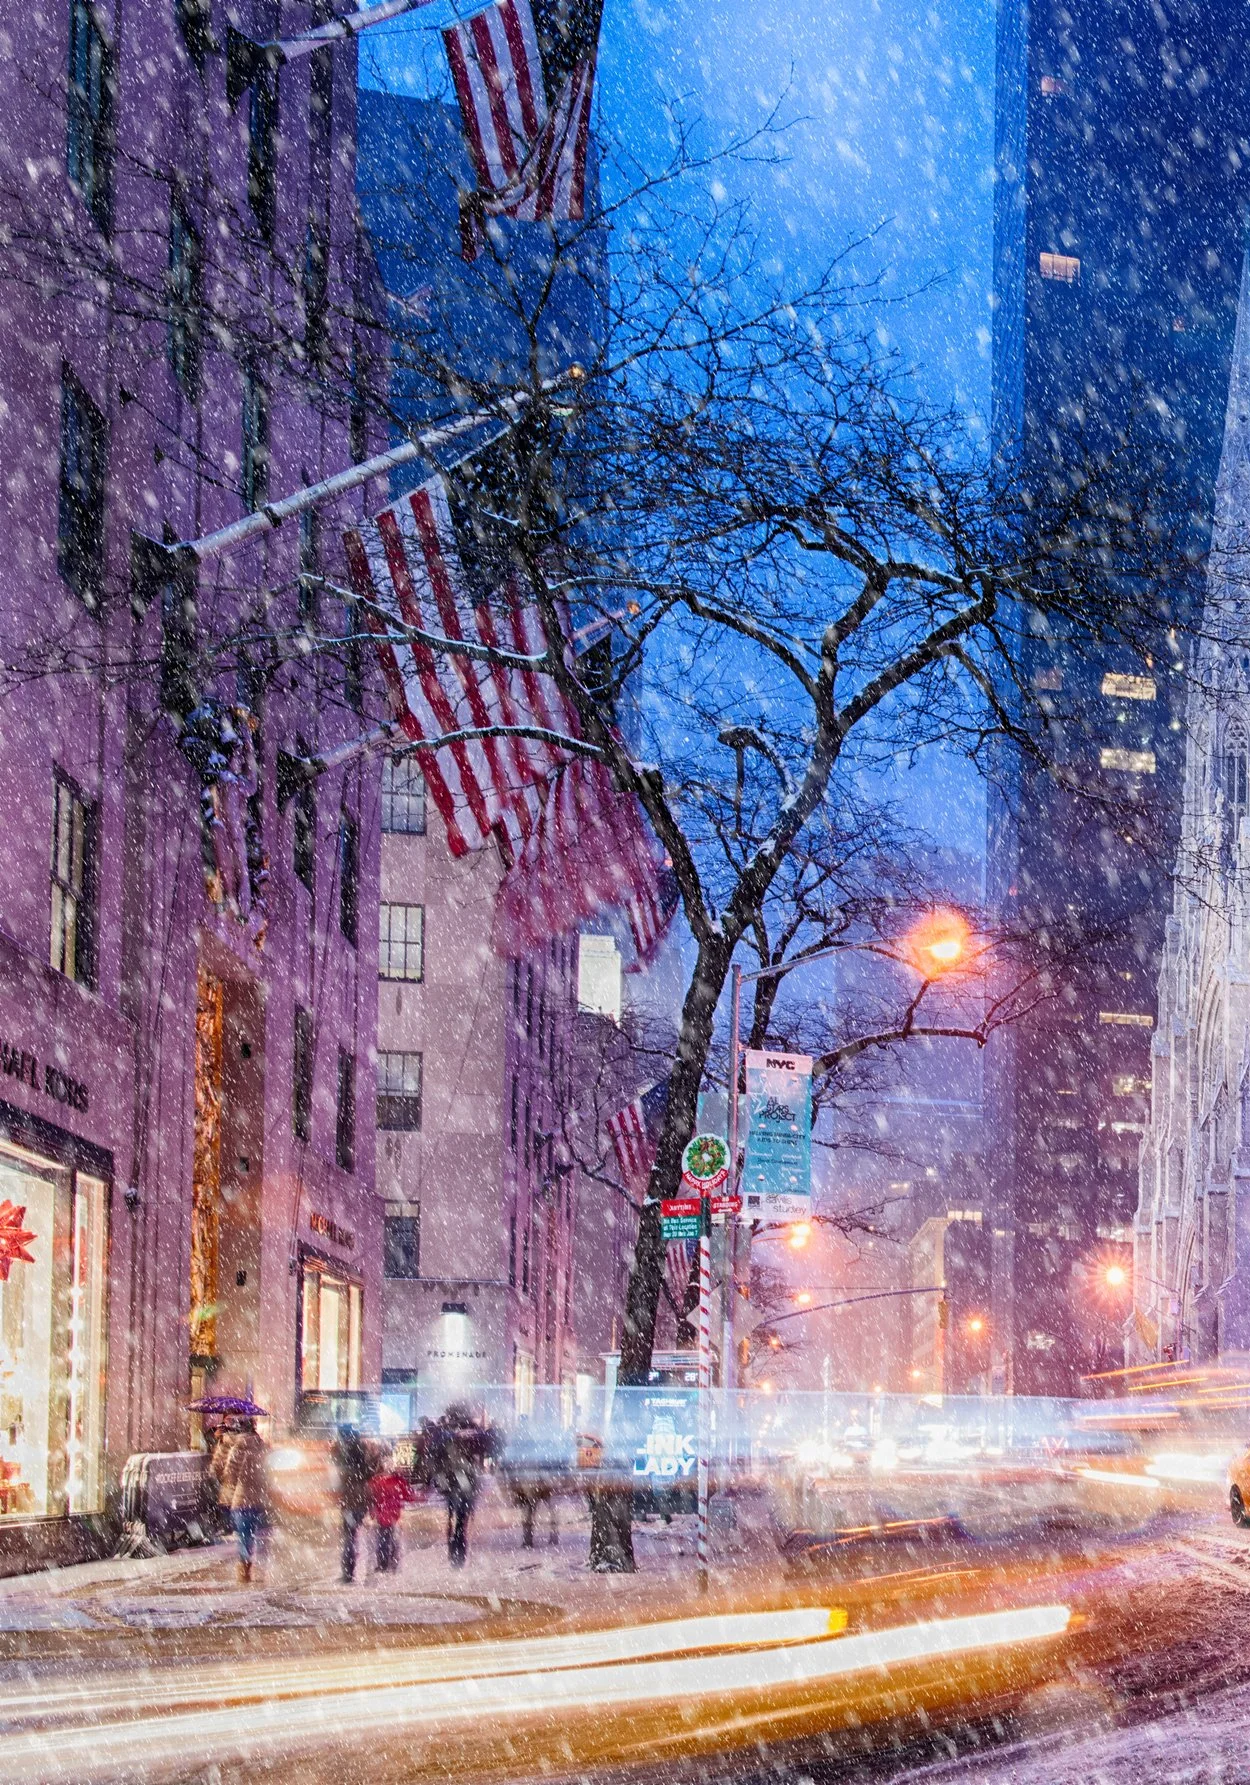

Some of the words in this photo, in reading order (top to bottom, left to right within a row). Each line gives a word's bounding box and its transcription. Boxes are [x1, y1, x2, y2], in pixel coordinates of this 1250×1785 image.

[766, 1058, 795, 1070] NYC
[45, 1065, 89, 1113] KORS
[759, 1111, 796, 1123] PROJECT
[685, 1172, 701, 1188] HAPPY
[701, 1170, 726, 1189] HOLIDAYS
[427, 1350, 486, 1359] PROMENADE
[633, 1457, 695, 1475] LADY
